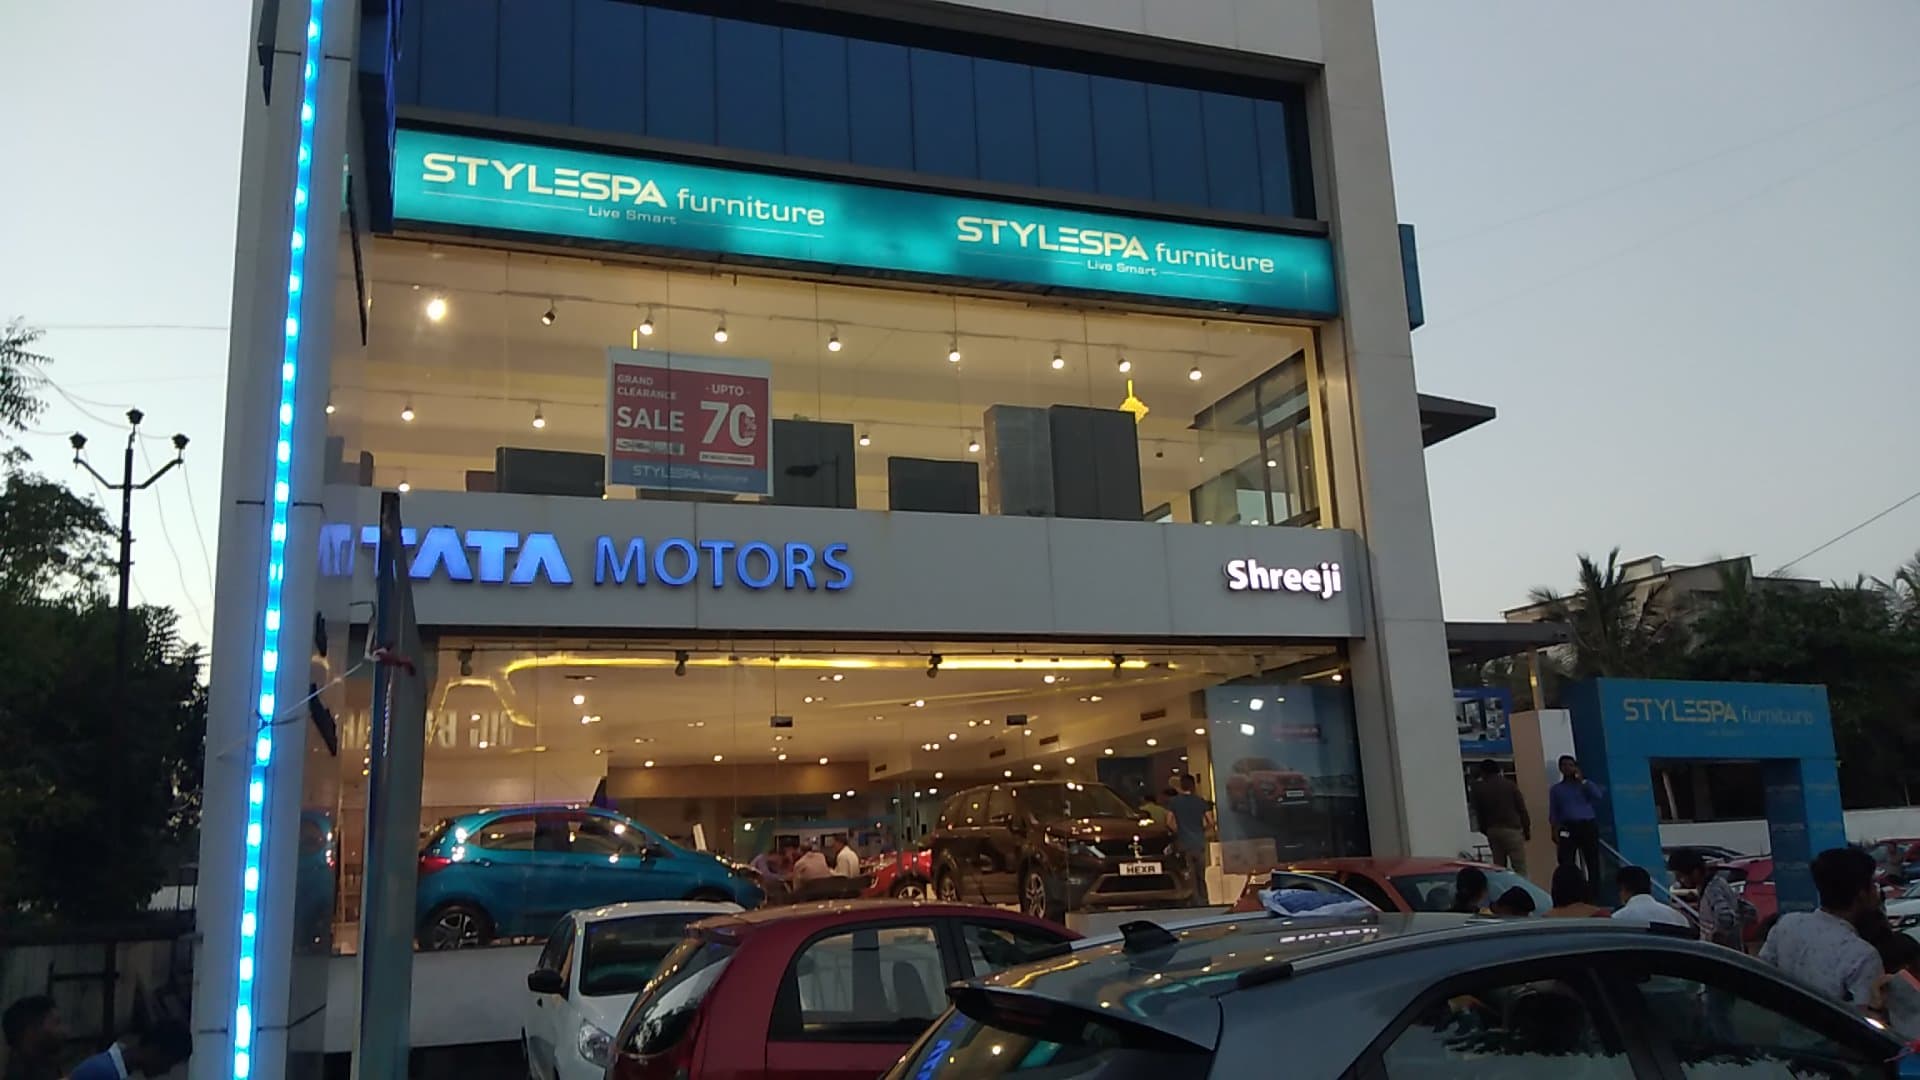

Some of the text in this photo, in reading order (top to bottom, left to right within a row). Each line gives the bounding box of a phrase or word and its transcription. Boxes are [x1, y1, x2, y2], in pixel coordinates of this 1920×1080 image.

[422, 152, 825, 226] STYLESPA furniture
[588, 205, 677, 225] Live Smart
[956, 215, 1275, 274] STYLESPA furniture
[1087, 260, 1157, 276] Live Smart
[617, 374, 654, 386] GRAND
[617, 387, 677, 400] CLEARANCE
[711, 384, 745, 397] UPTO
[617, 406, 685, 433] SALE
[594, 535, 855, 590] MOTORS
[1226, 558, 1343, 600] Shreeji
[1623, 697, 1738, 724] STYLESPA
